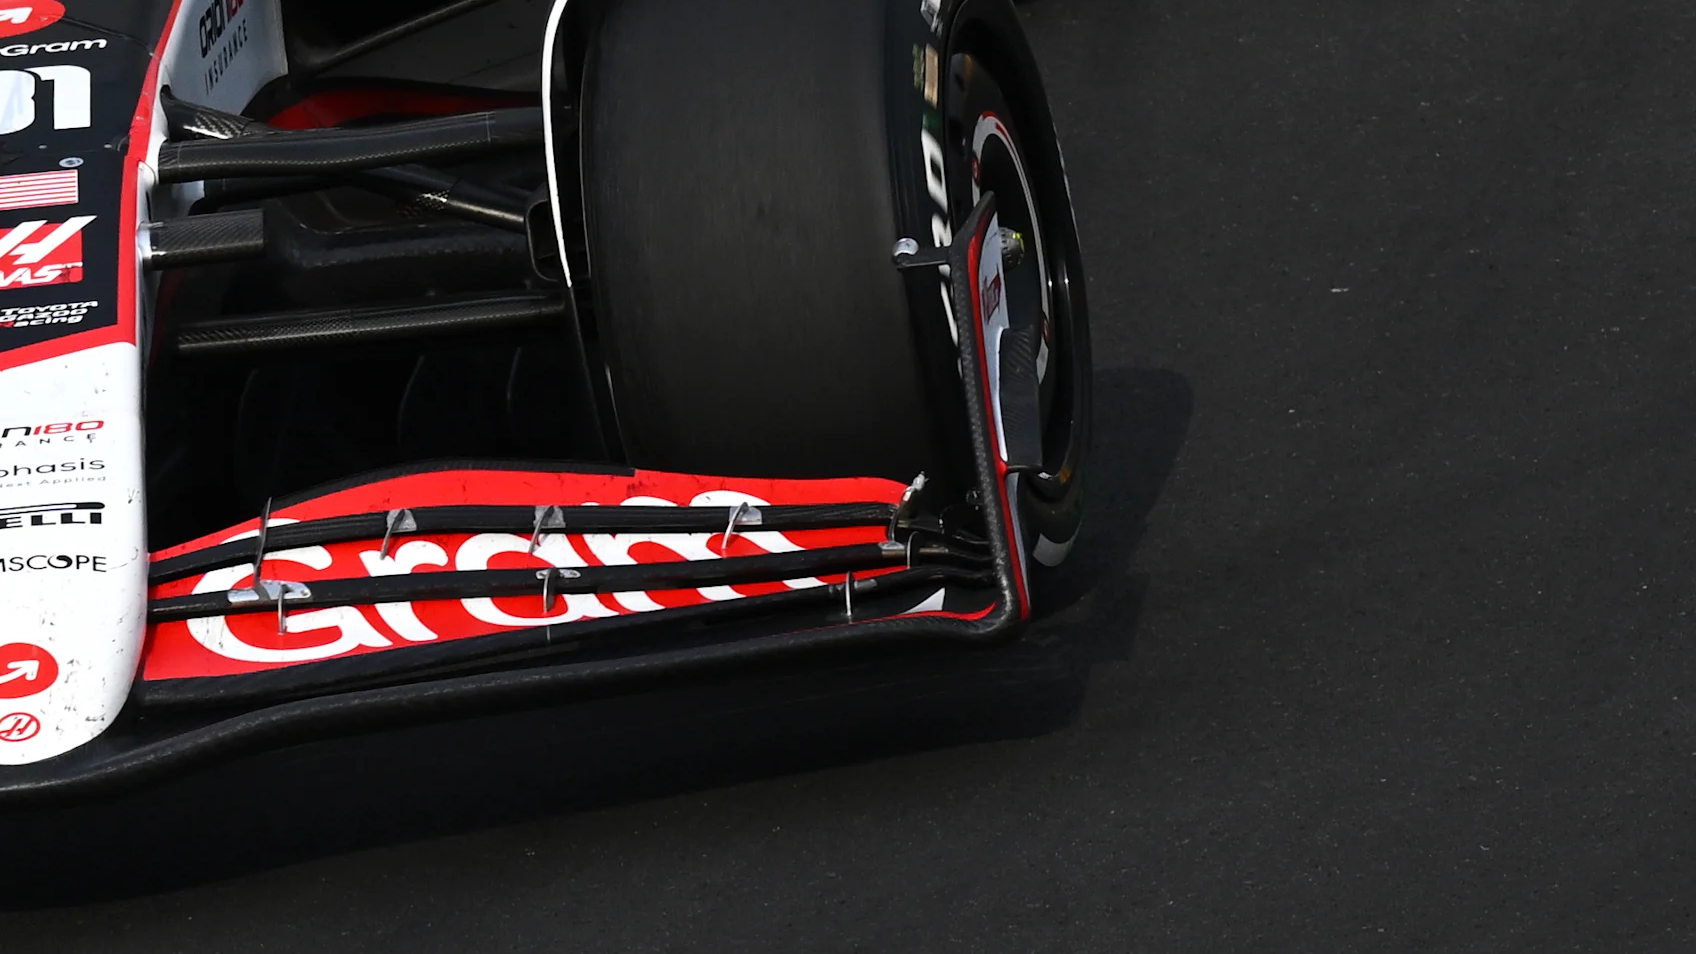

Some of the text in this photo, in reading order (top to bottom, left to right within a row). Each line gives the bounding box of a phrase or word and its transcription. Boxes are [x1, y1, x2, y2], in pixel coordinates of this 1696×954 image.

[0, 300, 99, 316] TOYOTA
[39, 475, 107, 486] Applied
[185, 490, 828, 664] Gram
